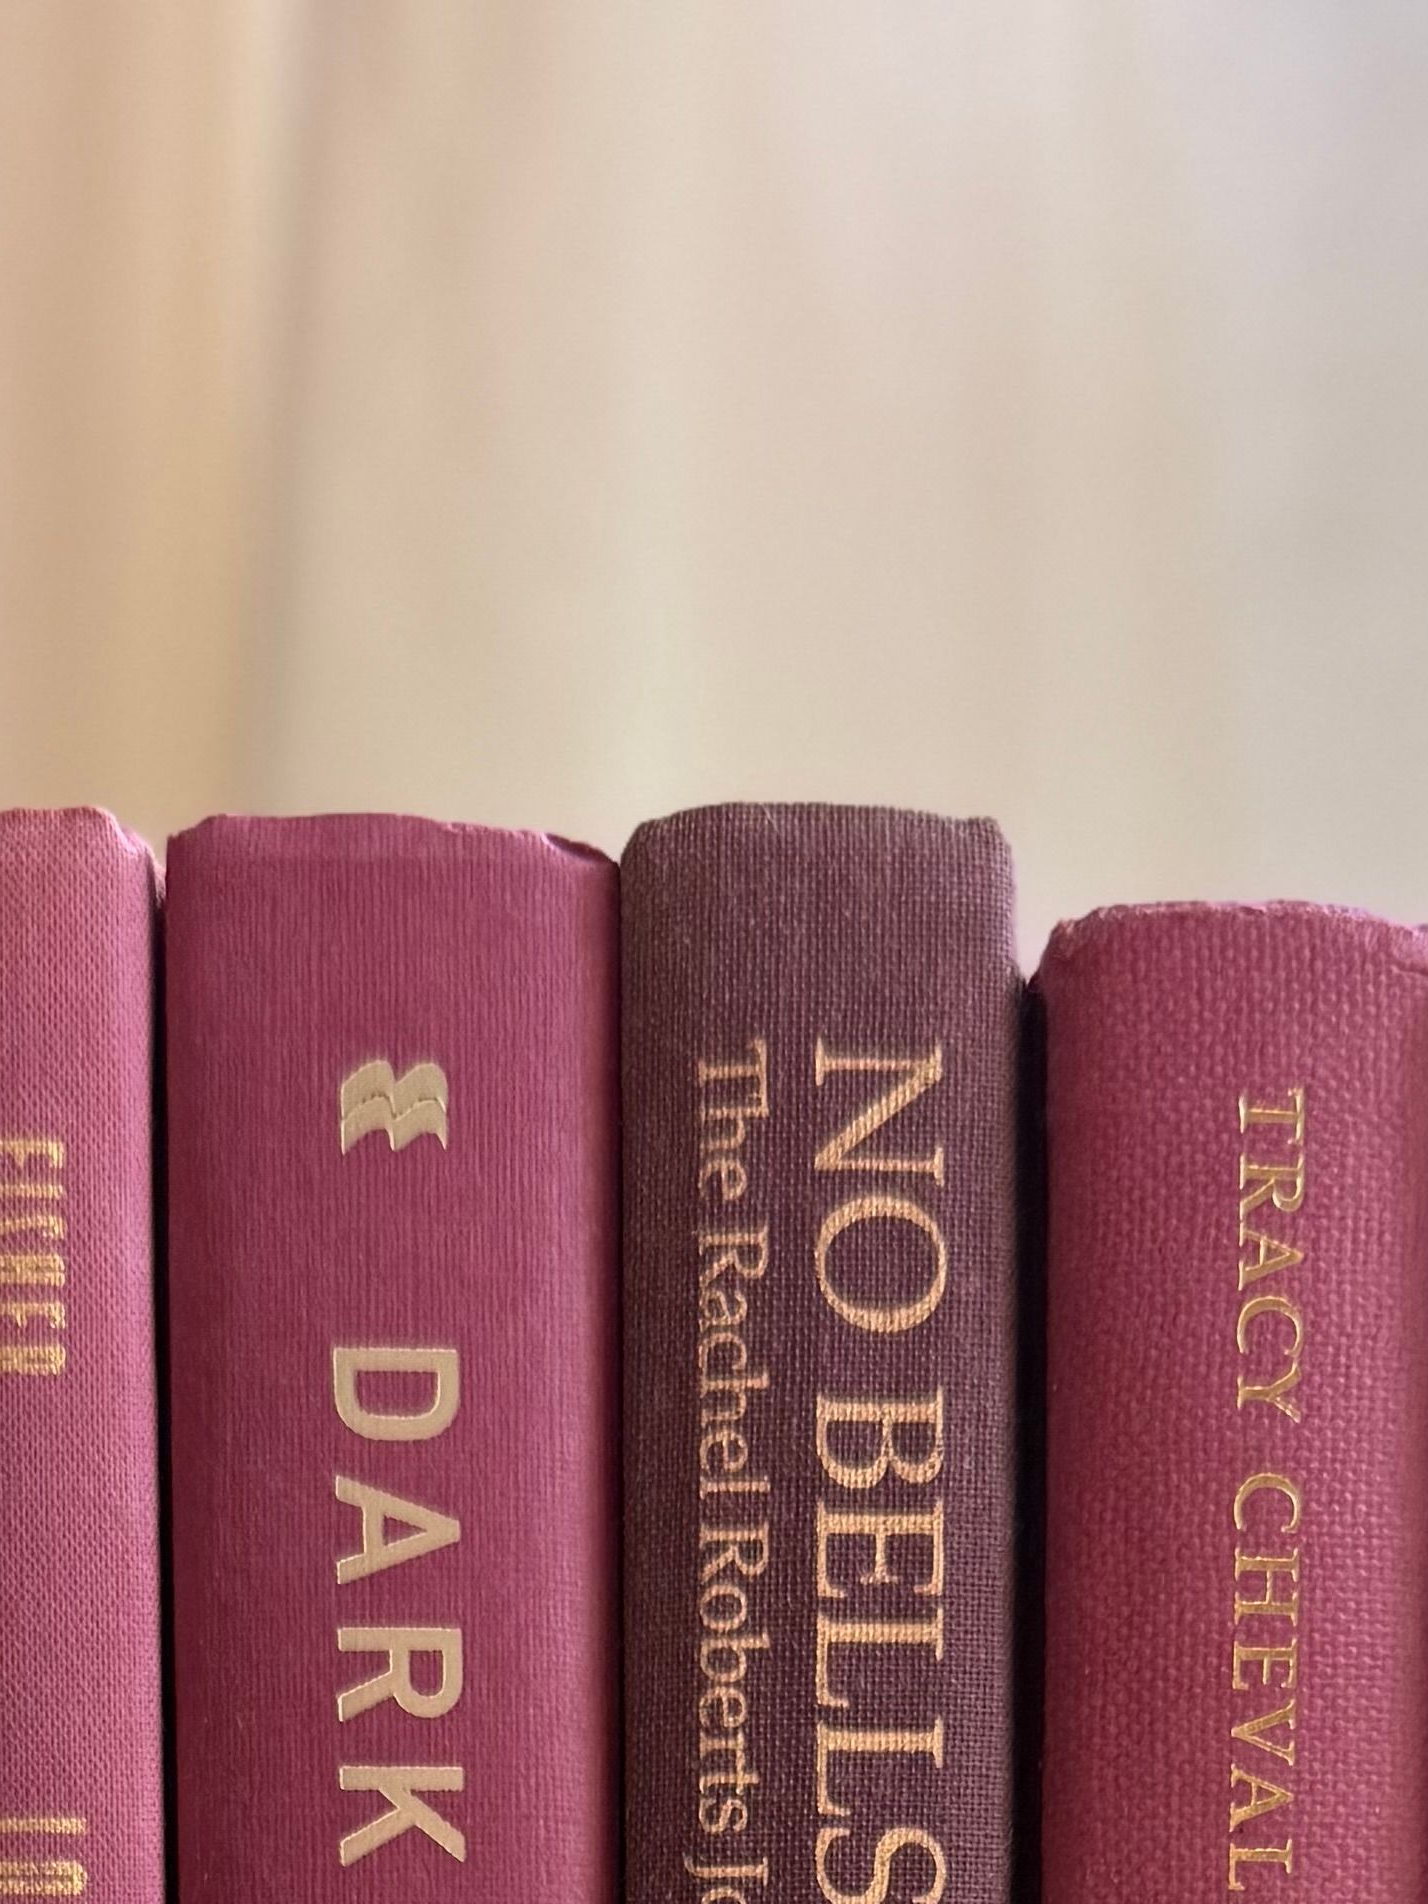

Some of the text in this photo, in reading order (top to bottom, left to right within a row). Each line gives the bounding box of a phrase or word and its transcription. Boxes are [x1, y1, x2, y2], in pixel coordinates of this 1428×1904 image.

[695, 1037, 770, 1203] The
[812, 1036, 948, 1334] NO
[1234, 1086, 1307, 1425] TRACY
[695, 1227, 771, 1500] Rachel
[332, 1344, 468, 1868] DARK
[695, 1520, 771, 1831] Roberts
